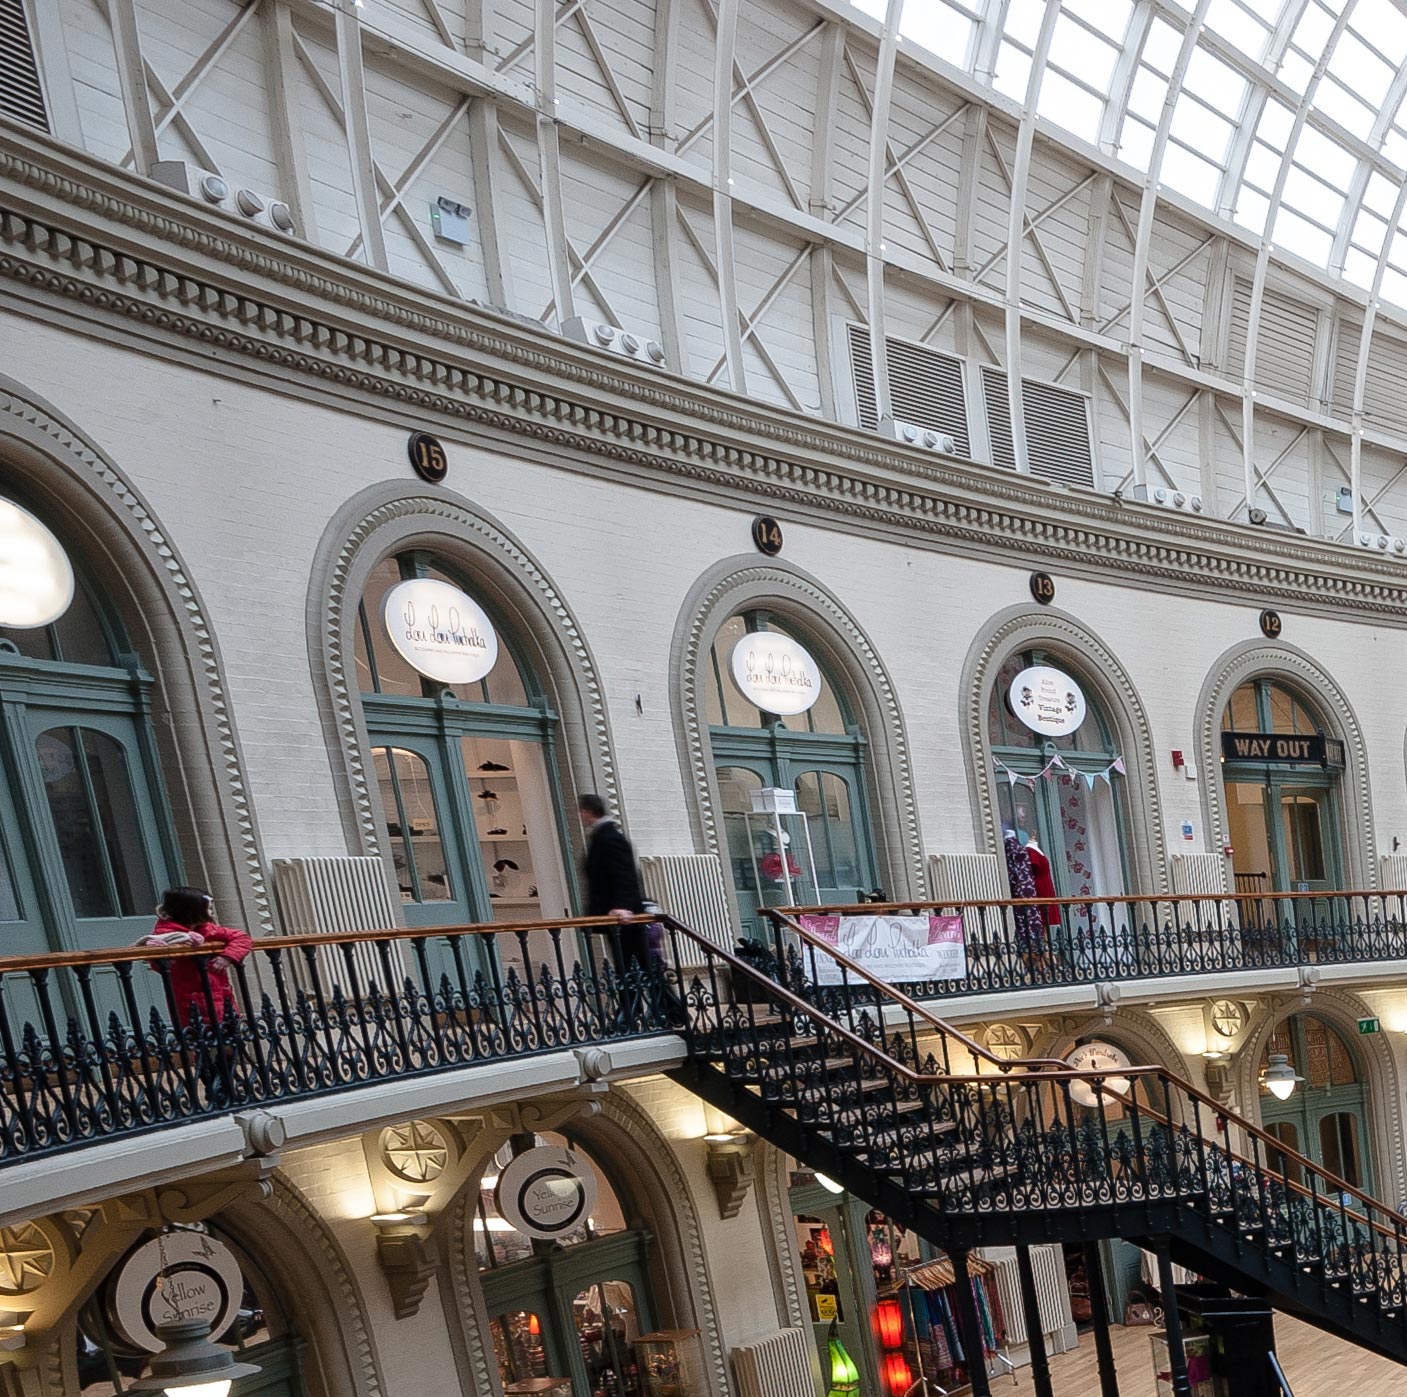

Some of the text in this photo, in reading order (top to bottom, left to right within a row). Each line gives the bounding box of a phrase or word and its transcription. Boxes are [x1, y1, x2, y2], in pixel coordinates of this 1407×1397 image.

[419, 442, 444, 471] 15
[760, 523, 782, 546] 14
[1036, 577, 1053, 596] 13
[1265, 615, 1280, 632] 12
[1037, 703, 1063, 714] Vintage
[1037, 714, 1066, 725] Boutique
[1234, 738, 1272, 757] WAY
[1276, 740, 1311, 758] OUT
[533, 1200, 575, 1217] Sunrise
